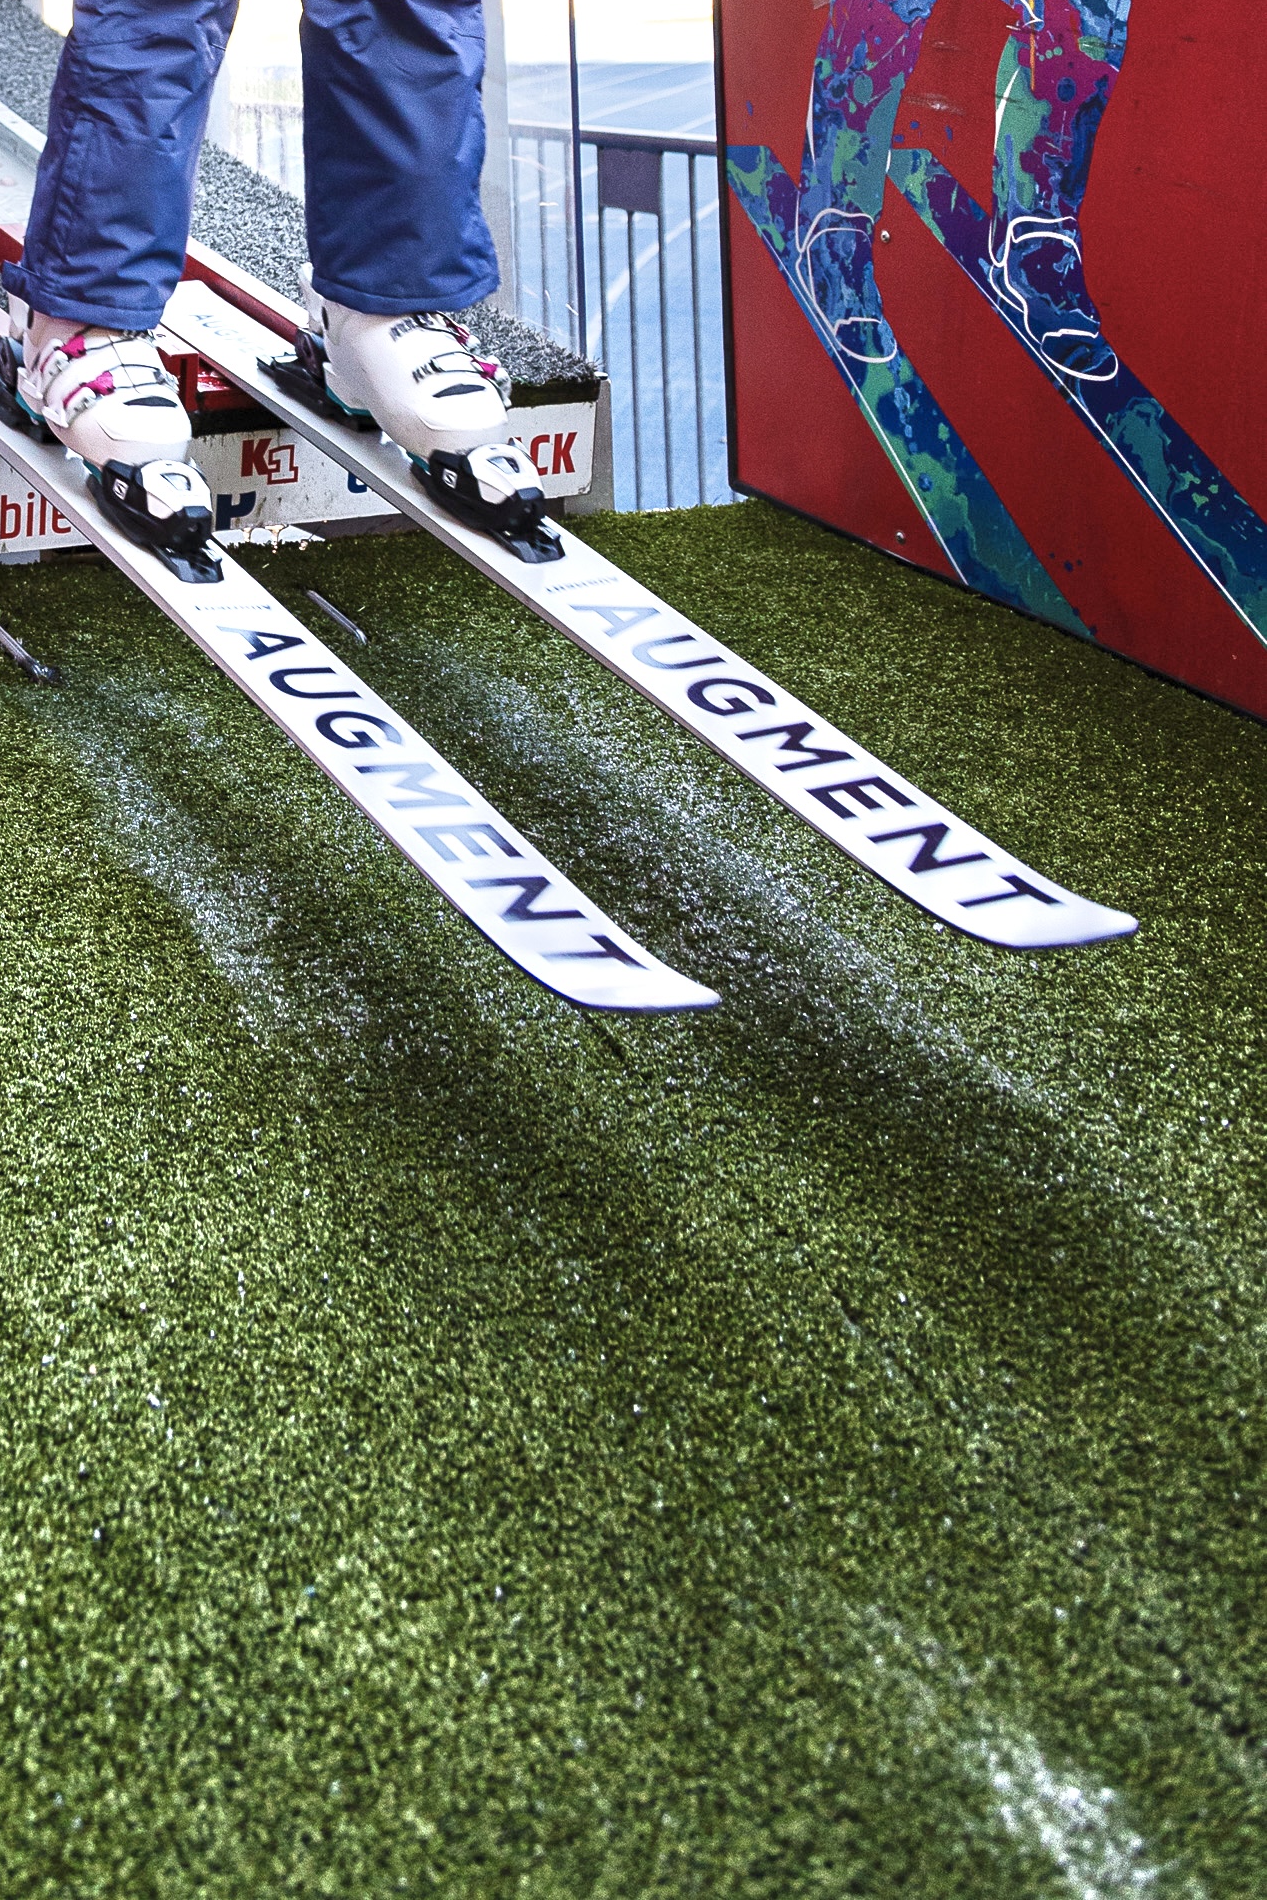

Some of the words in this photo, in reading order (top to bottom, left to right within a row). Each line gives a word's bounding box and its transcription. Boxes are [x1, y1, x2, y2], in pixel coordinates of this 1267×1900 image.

[240, 438, 299, 485] K1
[217, 624, 650, 970] AUGMENT
[566, 602, 1066, 910] AUGMENT
